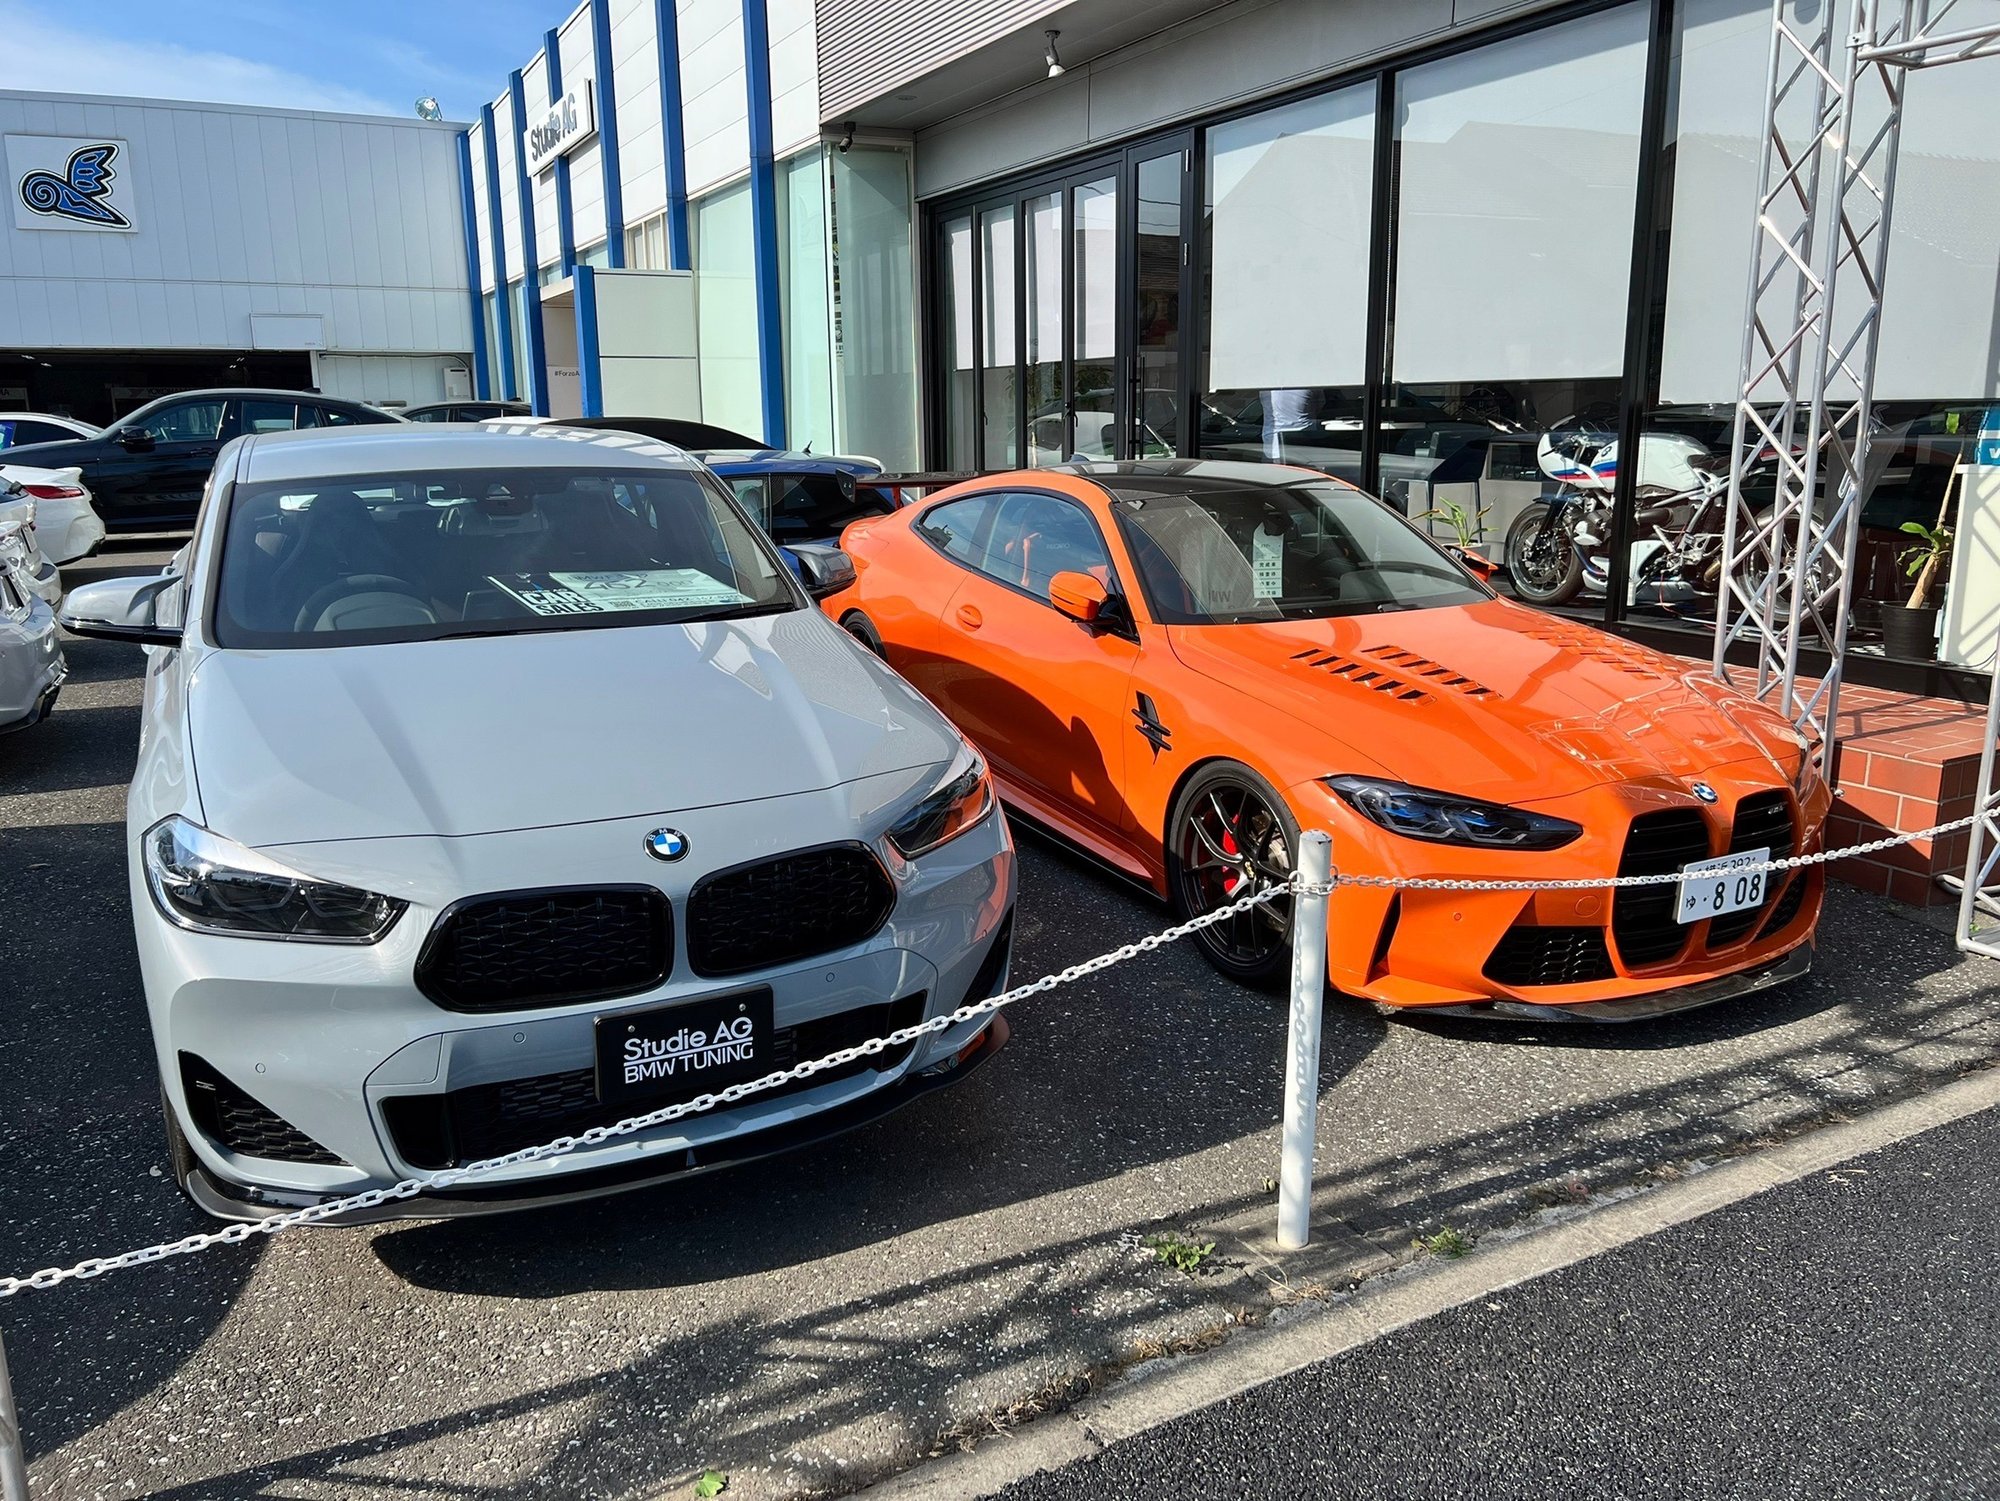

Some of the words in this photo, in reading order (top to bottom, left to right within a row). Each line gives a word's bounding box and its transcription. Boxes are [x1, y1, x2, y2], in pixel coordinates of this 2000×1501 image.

[530, 111, 561, 161] Studie
[562, 92, 577, 138] AG
[522, 591, 589, 605] CAR
[536, 602, 604, 615] SALES
[647, 828, 682, 841] BMW
[623, 1028, 707, 1061] Studie
[712, 1016, 753, 1044] AG
[624, 1057, 676, 1084] BMW
[678, 1042, 754, 1072] TUNING
